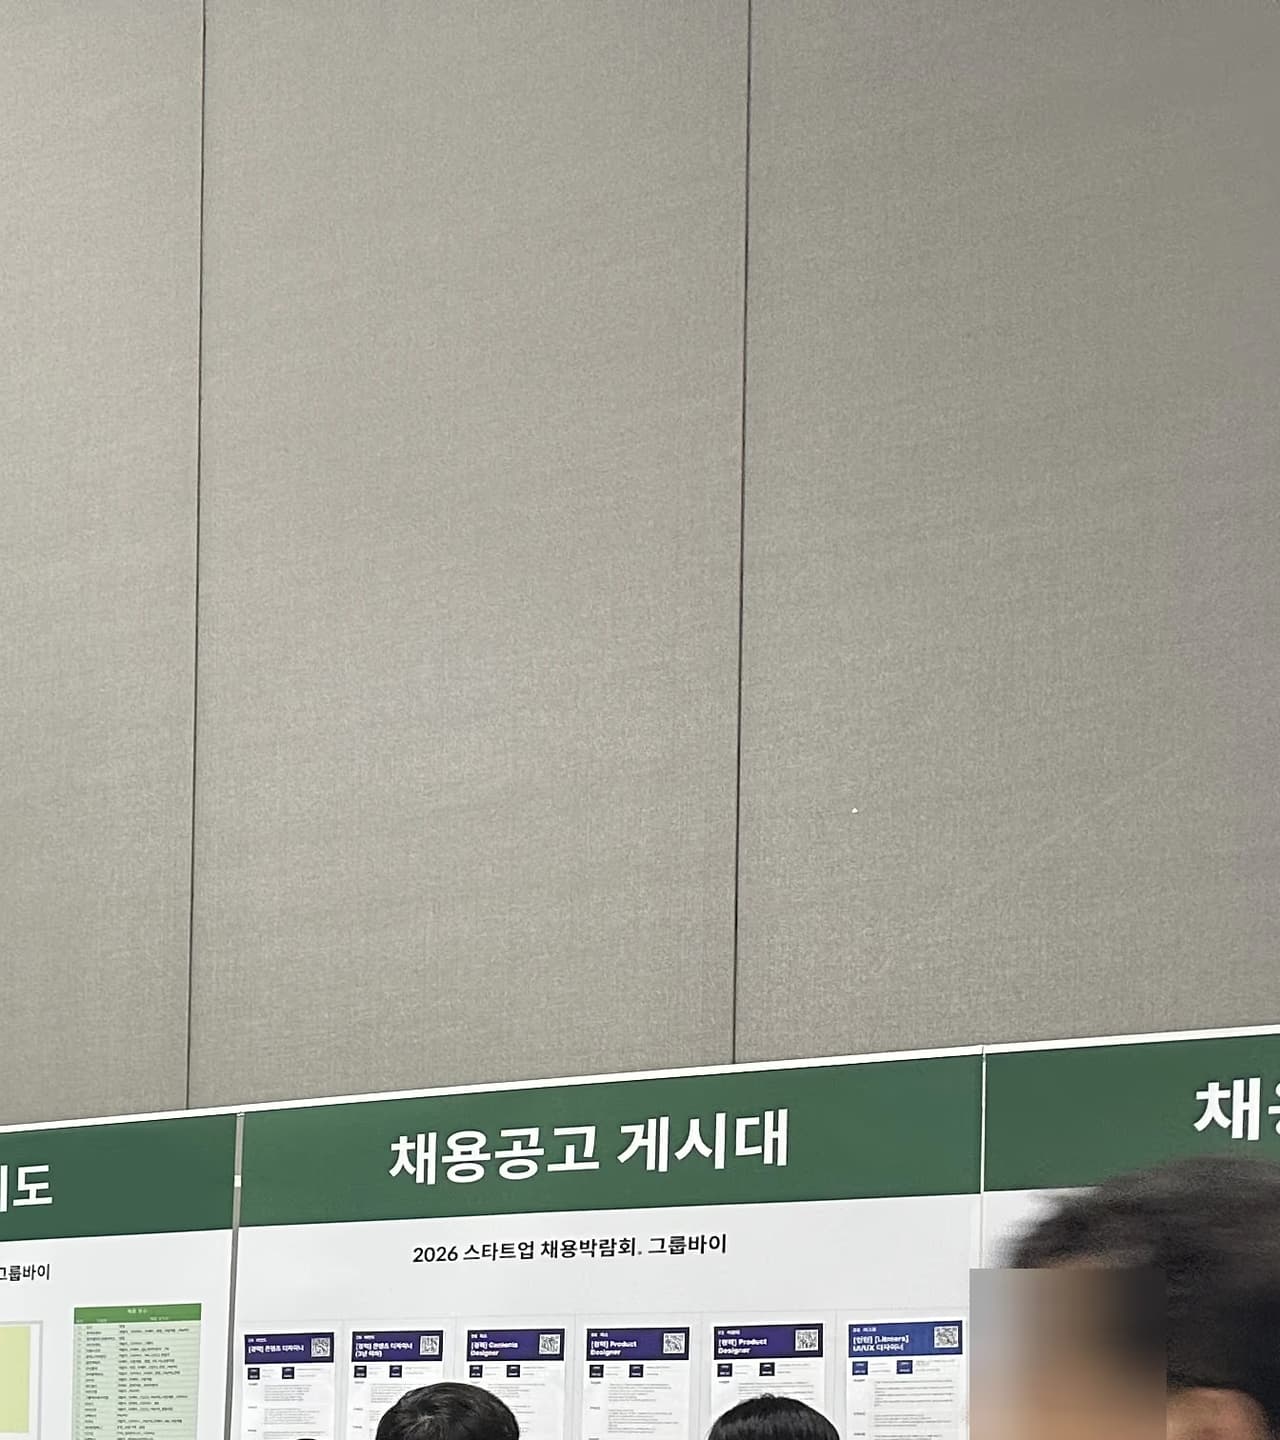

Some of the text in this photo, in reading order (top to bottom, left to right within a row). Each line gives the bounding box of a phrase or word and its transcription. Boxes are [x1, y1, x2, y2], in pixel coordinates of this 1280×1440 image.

[389, 1109, 787, 1184] 채용공고 게시대
[413, 1246, 458, 1262] 2026
[463, 1241, 534, 1261] 스타트업
[648, 1234, 726, 1255] 그룹바이
[609, 1340, 638, 1349] Product
[738, 1338, 768, 1346] Product
